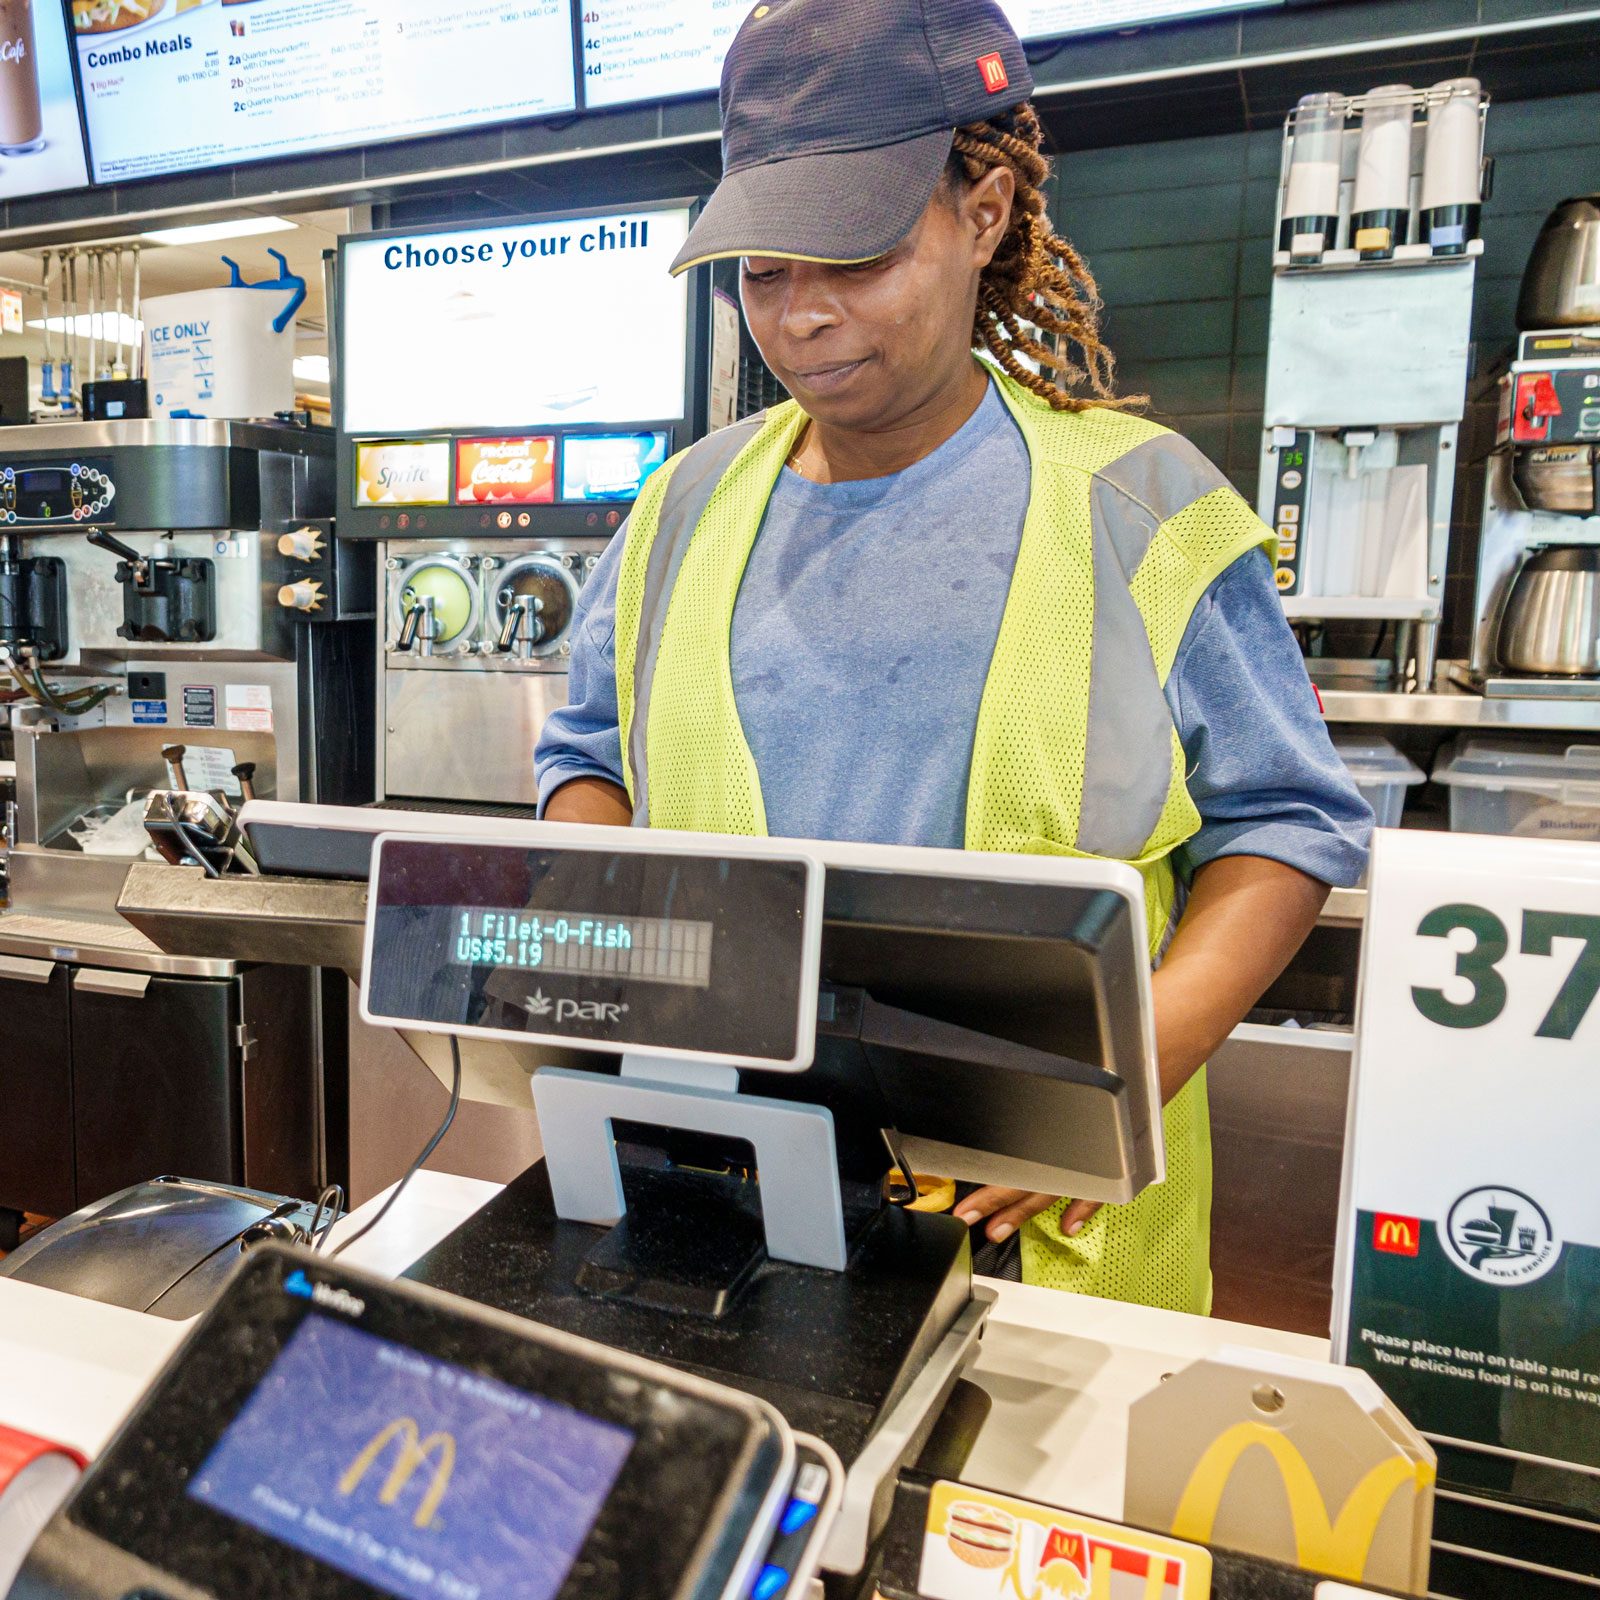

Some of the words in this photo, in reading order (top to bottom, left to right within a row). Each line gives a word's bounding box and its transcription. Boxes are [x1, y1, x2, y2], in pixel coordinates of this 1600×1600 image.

[396, 22, 404, 34] 3
[583, 11, 600, 23] 4b
[87, 44, 142, 68] Combo
[145, 34, 193, 58] Meals
[585, 38, 601, 49] 4c
[602, 33, 631, 45] Deluxe
[228, 55, 242, 66] 2a
[585, 62, 602, 76] 4d
[603, 60, 626, 72] Spicy
[628, 55, 658, 67] Deluxe
[230, 77, 244, 89] 2b
[233, 101, 247, 113] 2c
[384, 241, 494, 271] Choose
[502, 235, 572, 268] your
[580, 220, 649, 253] chill
[150, 326, 170, 343] ICE
[174, 320, 211, 339] ONLY
[377, 464, 430, 488] Sprite
[460, 912, 469, 936] 1
[482, 913, 632, 949] Filet-O-Fish
[457, 937, 543, 967] US$5.19
[1411, 903, 1600, 1040] 37
[1487, 1267, 1519, 1277] TABLE
[1521, 1244, 1552, 1274] SERVICE
[1360, 1328, 1411, 1350] Please
[1412, 1339, 1452, 1357] place
[1453, 1346, 1485, 1364] tent
[1487, 1354, 1507, 1368] on
[1508, 1357, 1548, 1375] table
[1550, 1366, 1580, 1381] and
[1374, 1347, 1408, 1366] Your
[1409, 1356, 1476, 1379] delicious
[1478, 1368, 1511, 1386] food
[1514, 1374, 1528, 1390] is
[1530, 1381, 1550, 1394] on
[1552, 1382, 1572, 1399] its
